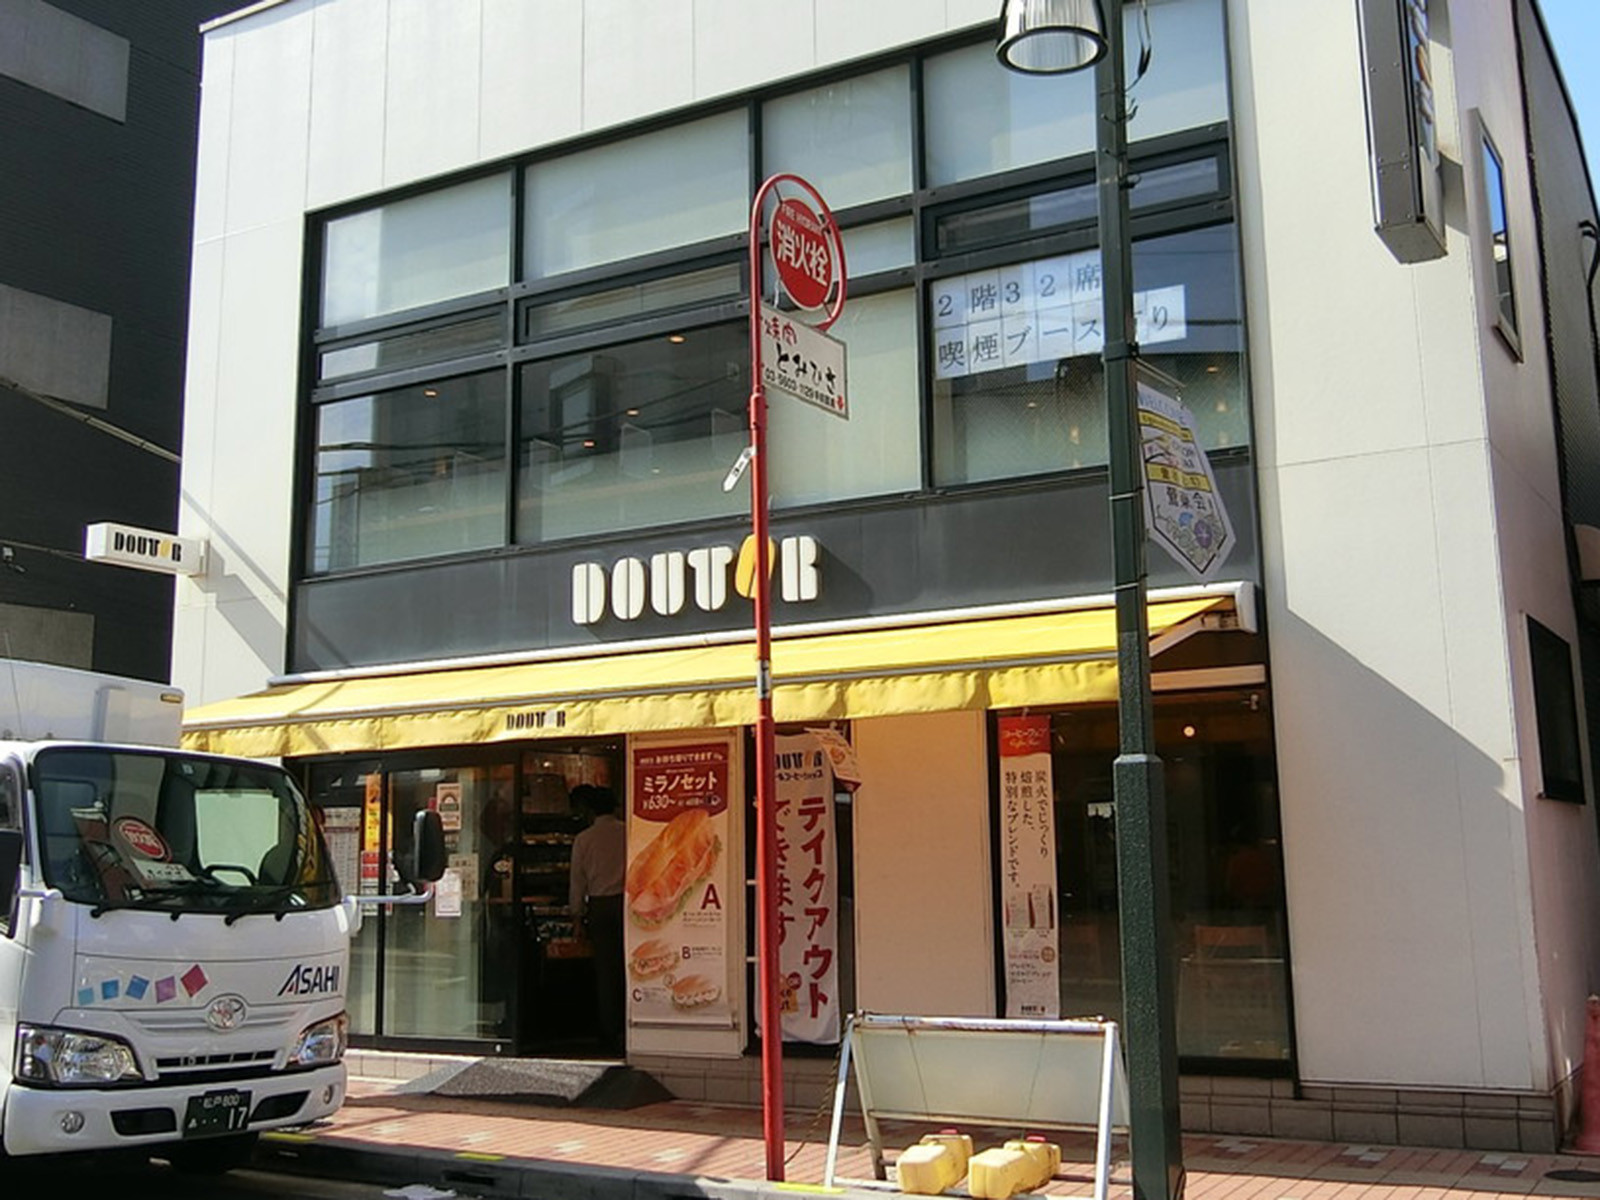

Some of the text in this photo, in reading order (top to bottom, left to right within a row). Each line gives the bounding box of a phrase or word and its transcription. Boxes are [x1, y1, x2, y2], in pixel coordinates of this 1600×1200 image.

[776, 219, 828, 287] 消火栓
[938, 305, 1168, 371] 喫煙ブースり
[776, 342, 837, 396] とみひさ
[113, 531, 182, 562] DOUTOR
[571, 533, 819, 625] DOUTOR
[643, 770, 718, 793] ミラノセット
[701, 883, 722, 910] A
[798, 796, 832, 1019] テイクアウト
[682, 946, 691, 960] B
[277, 964, 340, 996] ASAHI
[632, 988, 642, 1002] C
